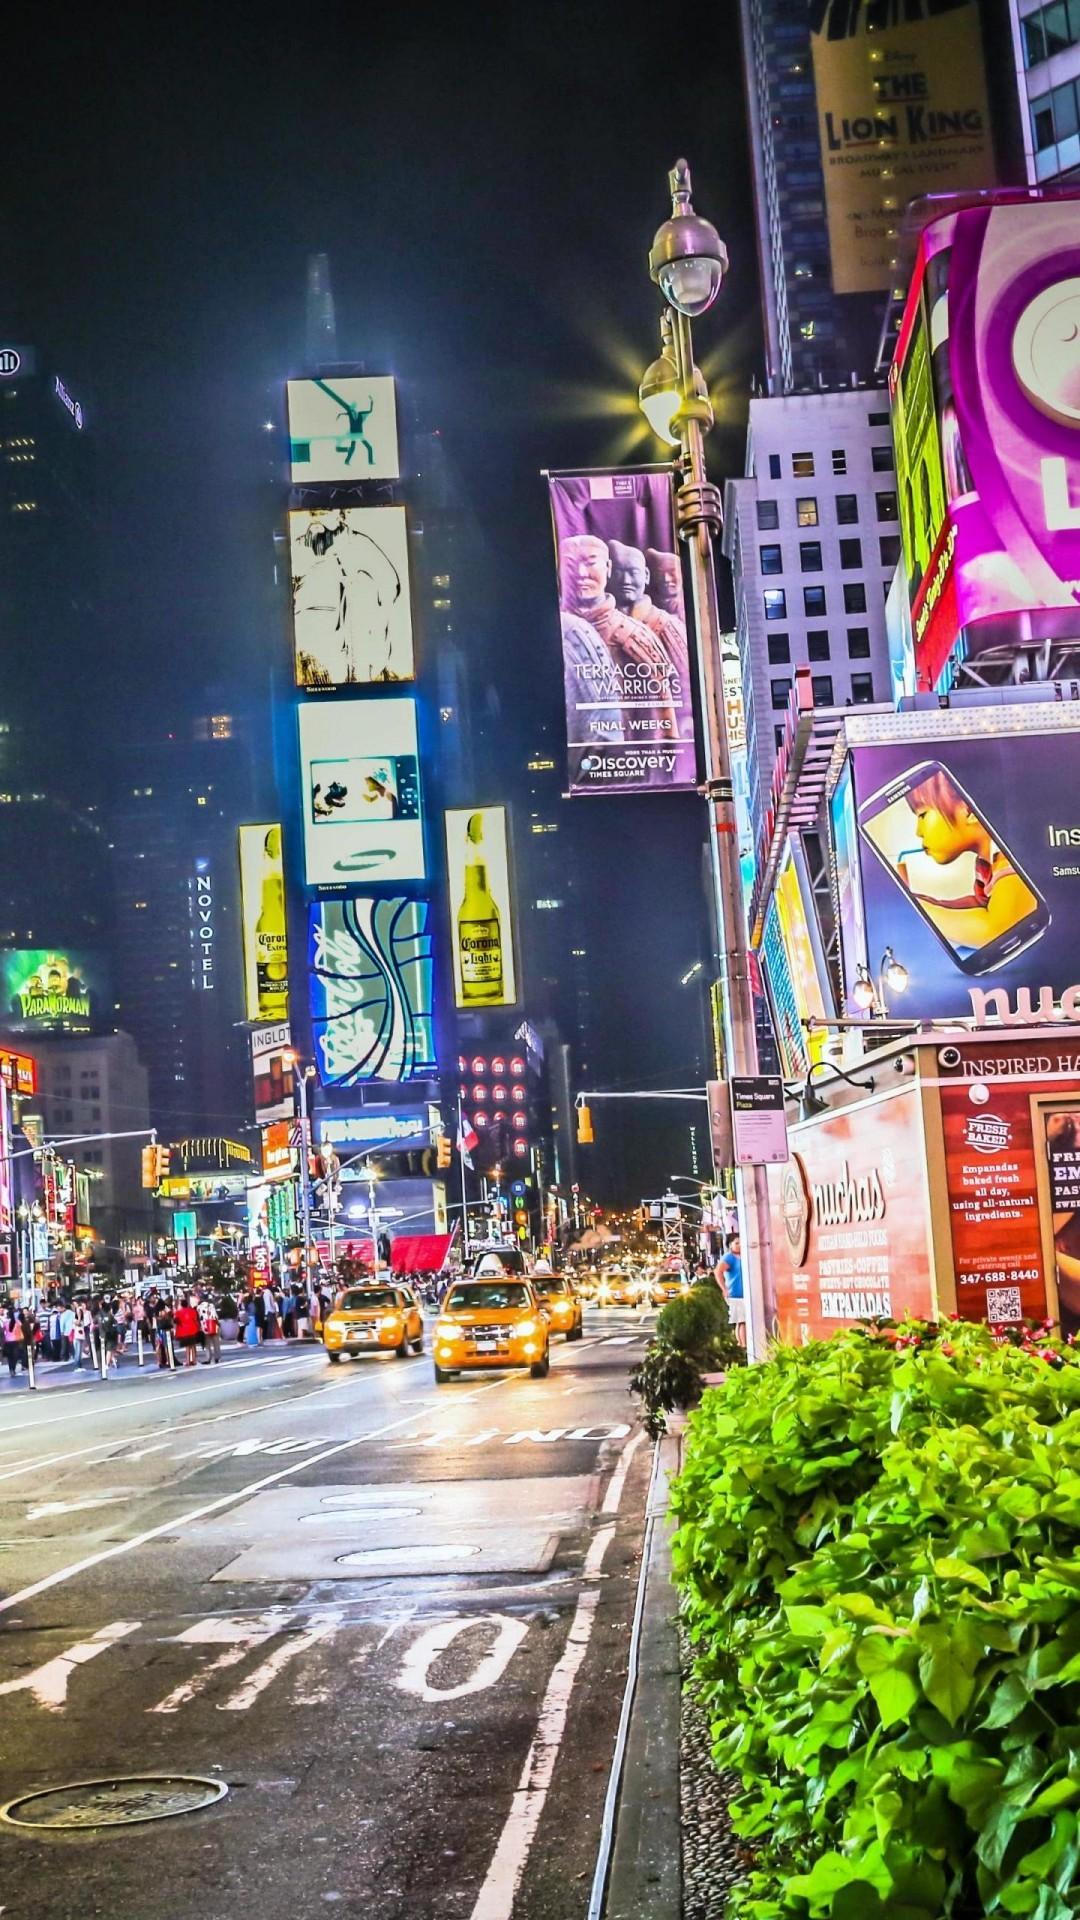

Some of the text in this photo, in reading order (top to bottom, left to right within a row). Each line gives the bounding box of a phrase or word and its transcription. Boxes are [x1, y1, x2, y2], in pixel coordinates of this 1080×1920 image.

[874, 72, 928, 98] THE
[825, 104, 983, 151] LION KING
[573, 662, 680, 679] TERRACOTTA
[592, 679, 682, 695] WARRIORS
[590, 719, 672, 732] FINAL WEEKS
[1049, 825, 1080, 847] Ins
[197, 876, 214, 989] NOVOTEL
[461, 937, 499, 951] Corona
[962, 1057, 1052, 1077] INSPIRED
[754, 1093, 775, 1101] Square
[968, 1122, 1008, 1136] FRESH
[967, 1132, 1007, 1145] BAKED
[962, 1163, 1018, 1175] Empanadas
[963, 1173, 1020, 1186] baked fresh
[975, 1186, 986, 1196] all
[1055, 1184, 1080, 1196] PAS
[953, 1196, 1034, 1211] using all-natural
[965, 1209, 1023, 1222] ingredients.
[820, 1292, 891, 1317] EMPANADAS
